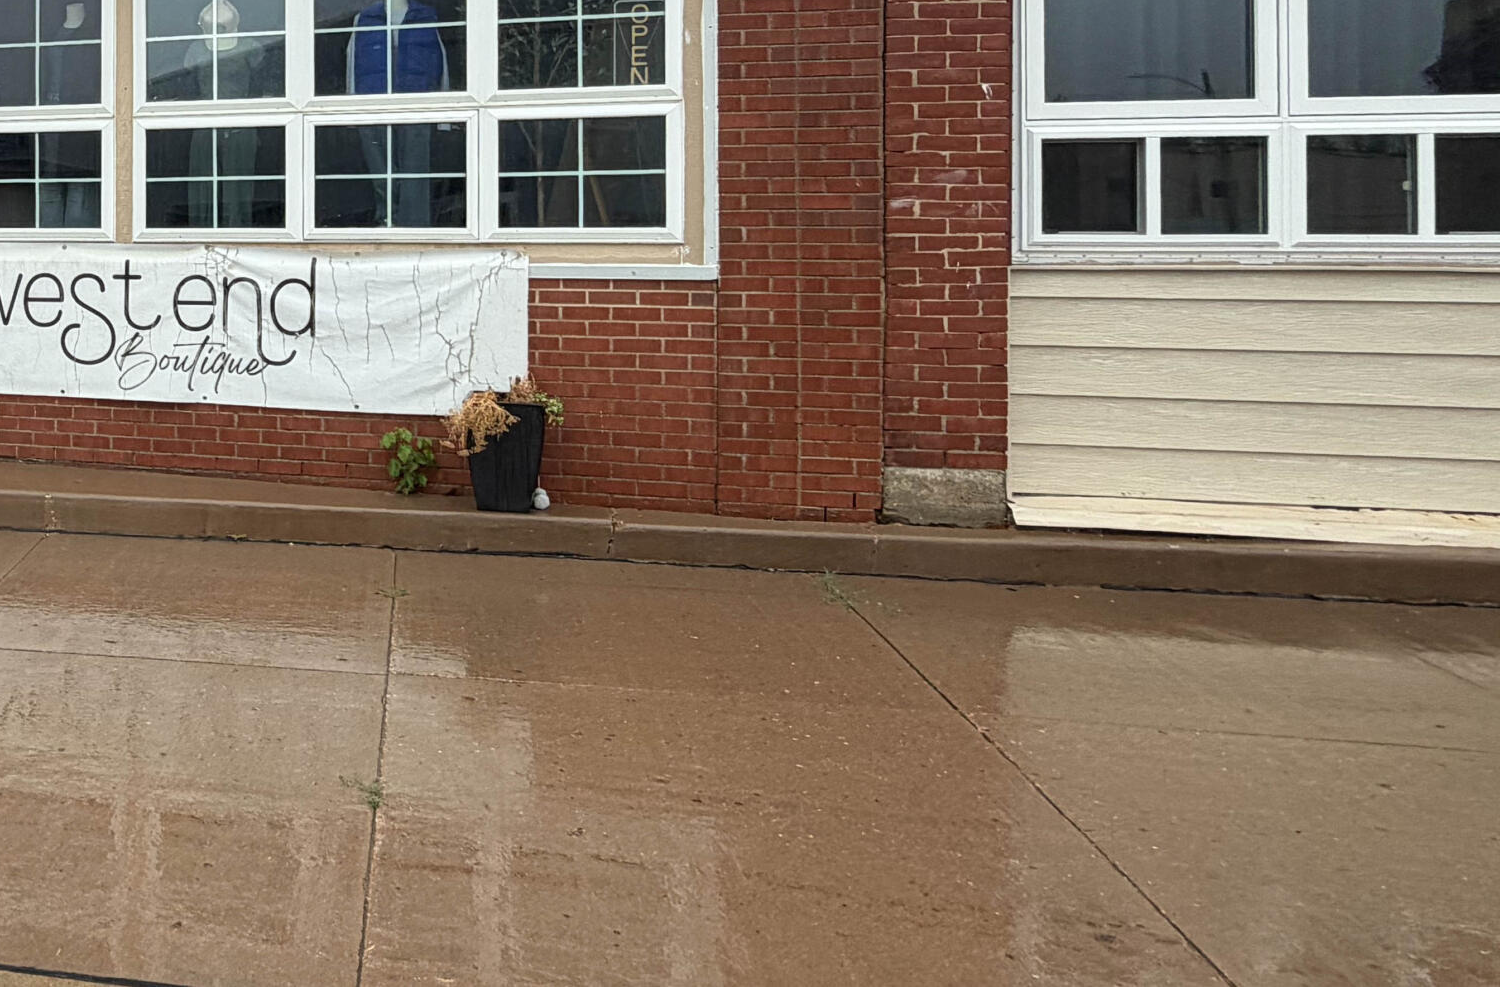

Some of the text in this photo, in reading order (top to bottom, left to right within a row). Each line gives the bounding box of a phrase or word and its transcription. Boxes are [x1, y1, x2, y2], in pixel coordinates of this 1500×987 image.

[630, 3, 650, 85] OPEN
[173, 257, 317, 365] end
[115, 332, 268, 393] Boutique
